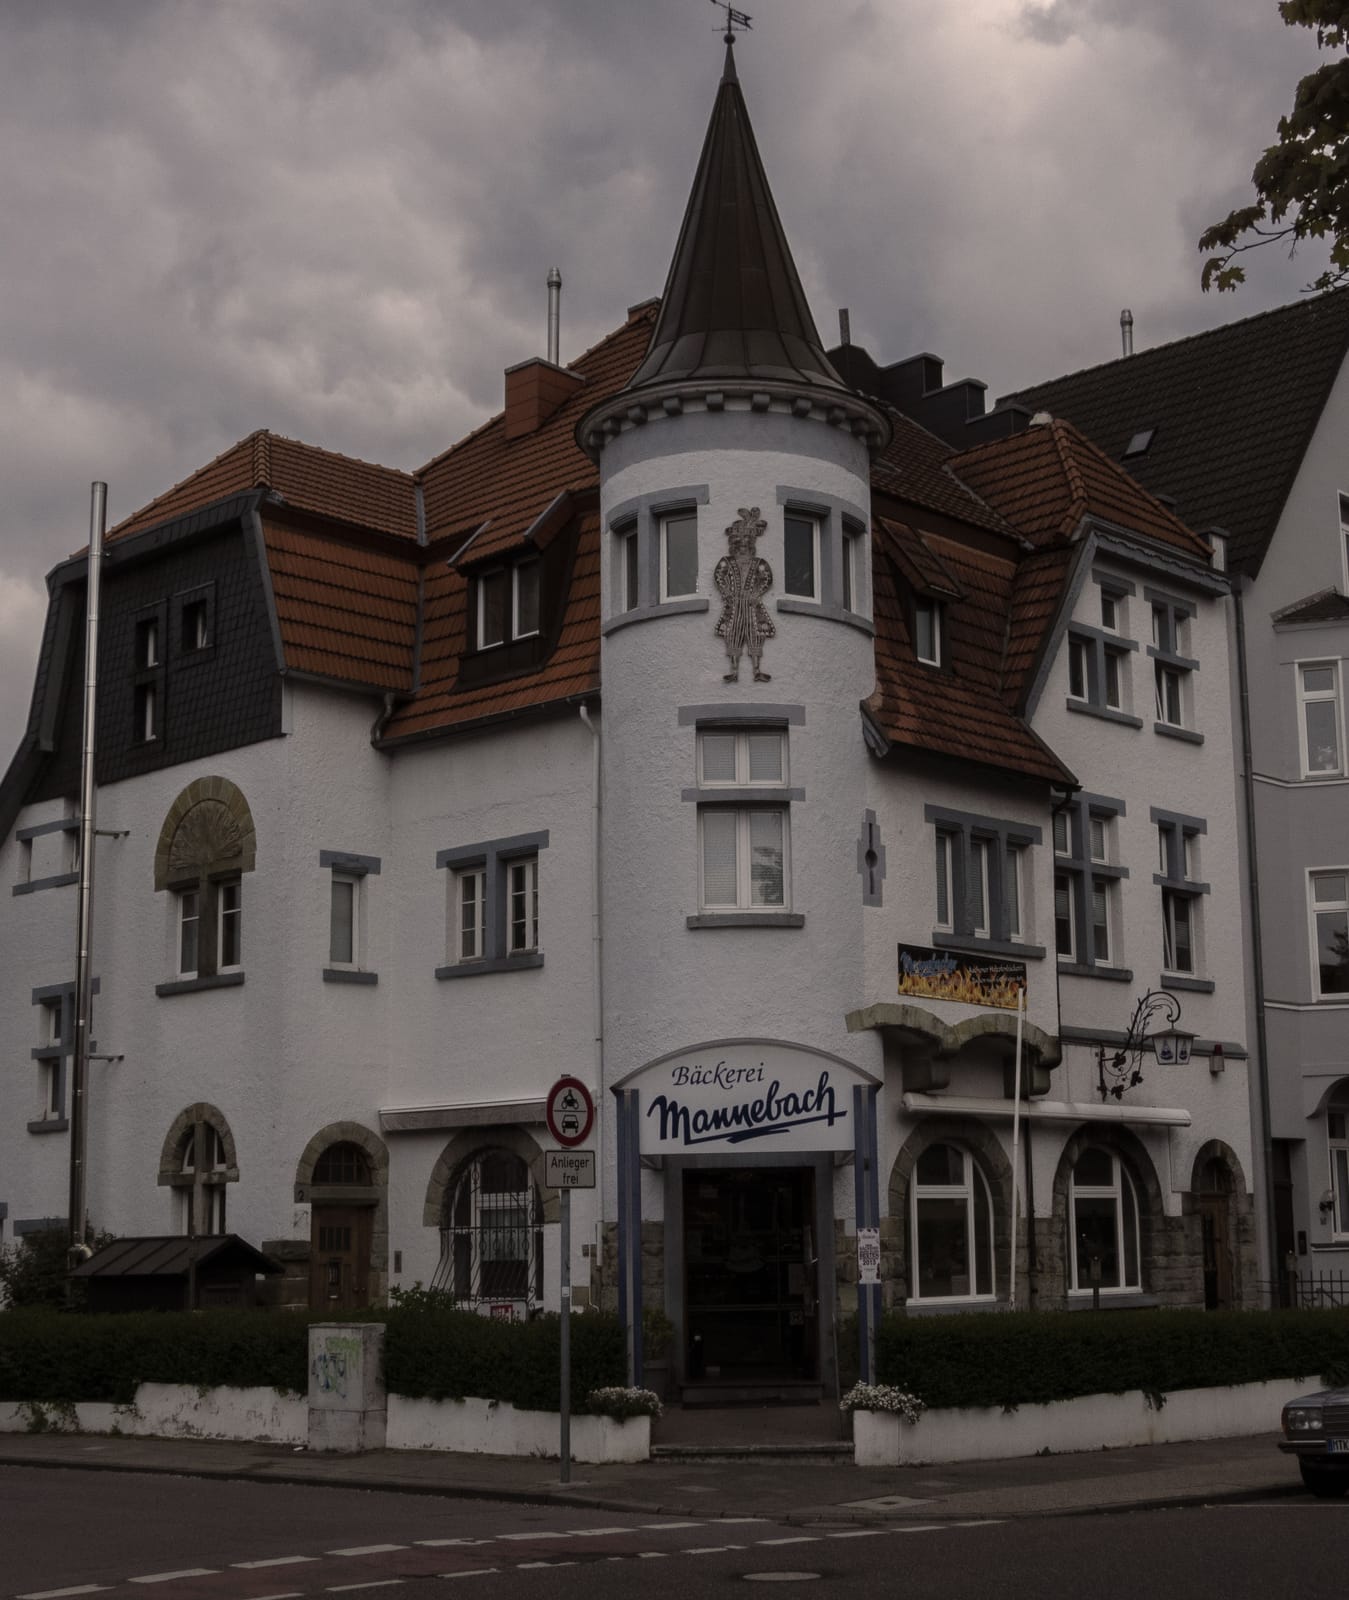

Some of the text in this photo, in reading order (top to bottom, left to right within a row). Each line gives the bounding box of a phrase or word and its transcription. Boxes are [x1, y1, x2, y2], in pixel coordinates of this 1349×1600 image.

[671, 1061, 765, 1090] Bäckerei
[647, 1071, 837, 1145] Mannebach
[550, 1156, 590, 1171] Anlieger
[562, 1173, 579, 1185] frei
[297, 1190, 305, 1201] 2
